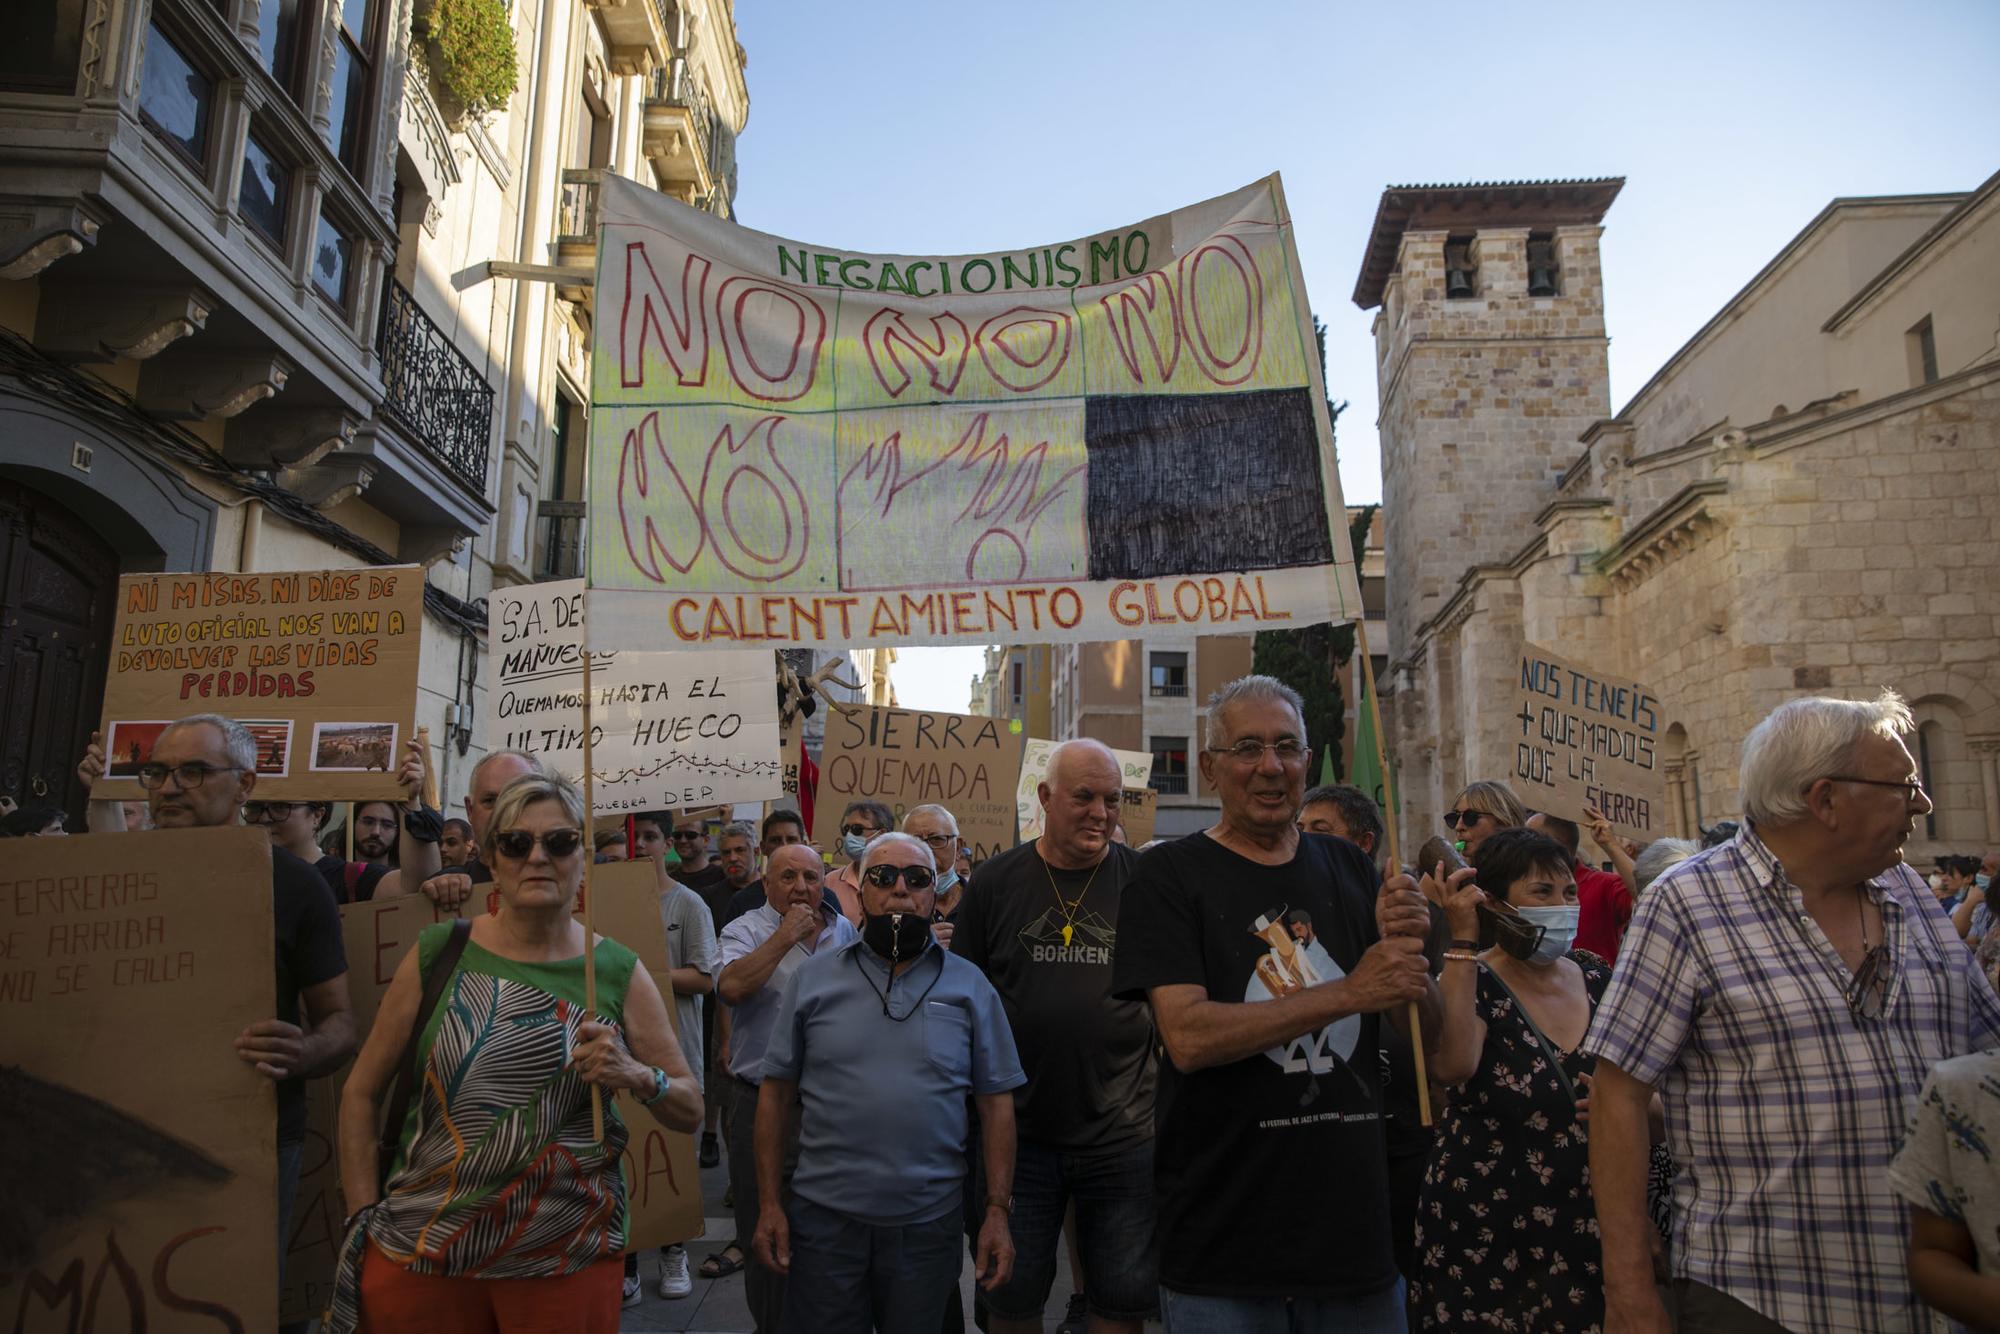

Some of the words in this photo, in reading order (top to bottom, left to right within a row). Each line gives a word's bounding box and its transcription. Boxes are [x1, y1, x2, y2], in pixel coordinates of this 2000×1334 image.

[778, 230, 1149, 296] NEGACIONISMO
[620, 241, 827, 401] NO
[863, 305, 1073, 397] NO
[1101, 233, 1264, 386] NO
[368, 576, 398, 600] DE
[669, 587, 1083, 642] CALENTAMIENTO
[1109, 576, 1291, 627] GLOBAL
[122, 621, 181, 647] LUTO
[278, 612, 323, 637] NOS
[332, 611, 378, 635] VAN
[387, 610, 405, 635] A
[118, 645, 239, 673] DEVOLVER
[249, 643, 291, 667] LAS
[1521, 656, 1562, 699] NOS
[601, 682, 669, 706] HASTA
[688, 676, 727, 698] EL
[633, 713, 741, 746] HUECO
[1541, 706, 1657, 771] QUEMADOS
[829, 755, 990, 800] QUEMADA
[1517, 742, 1556, 787] QUE
[1568, 752, 1596, 782] LA
[47, 915, 164, 957] ARRIBA
[1032, 944, 1110, 965] BORIKEN
[0, 970, 36, 1002] NO
[49, 963, 91, 995] SE
[113, 951, 194, 987] CALLA
